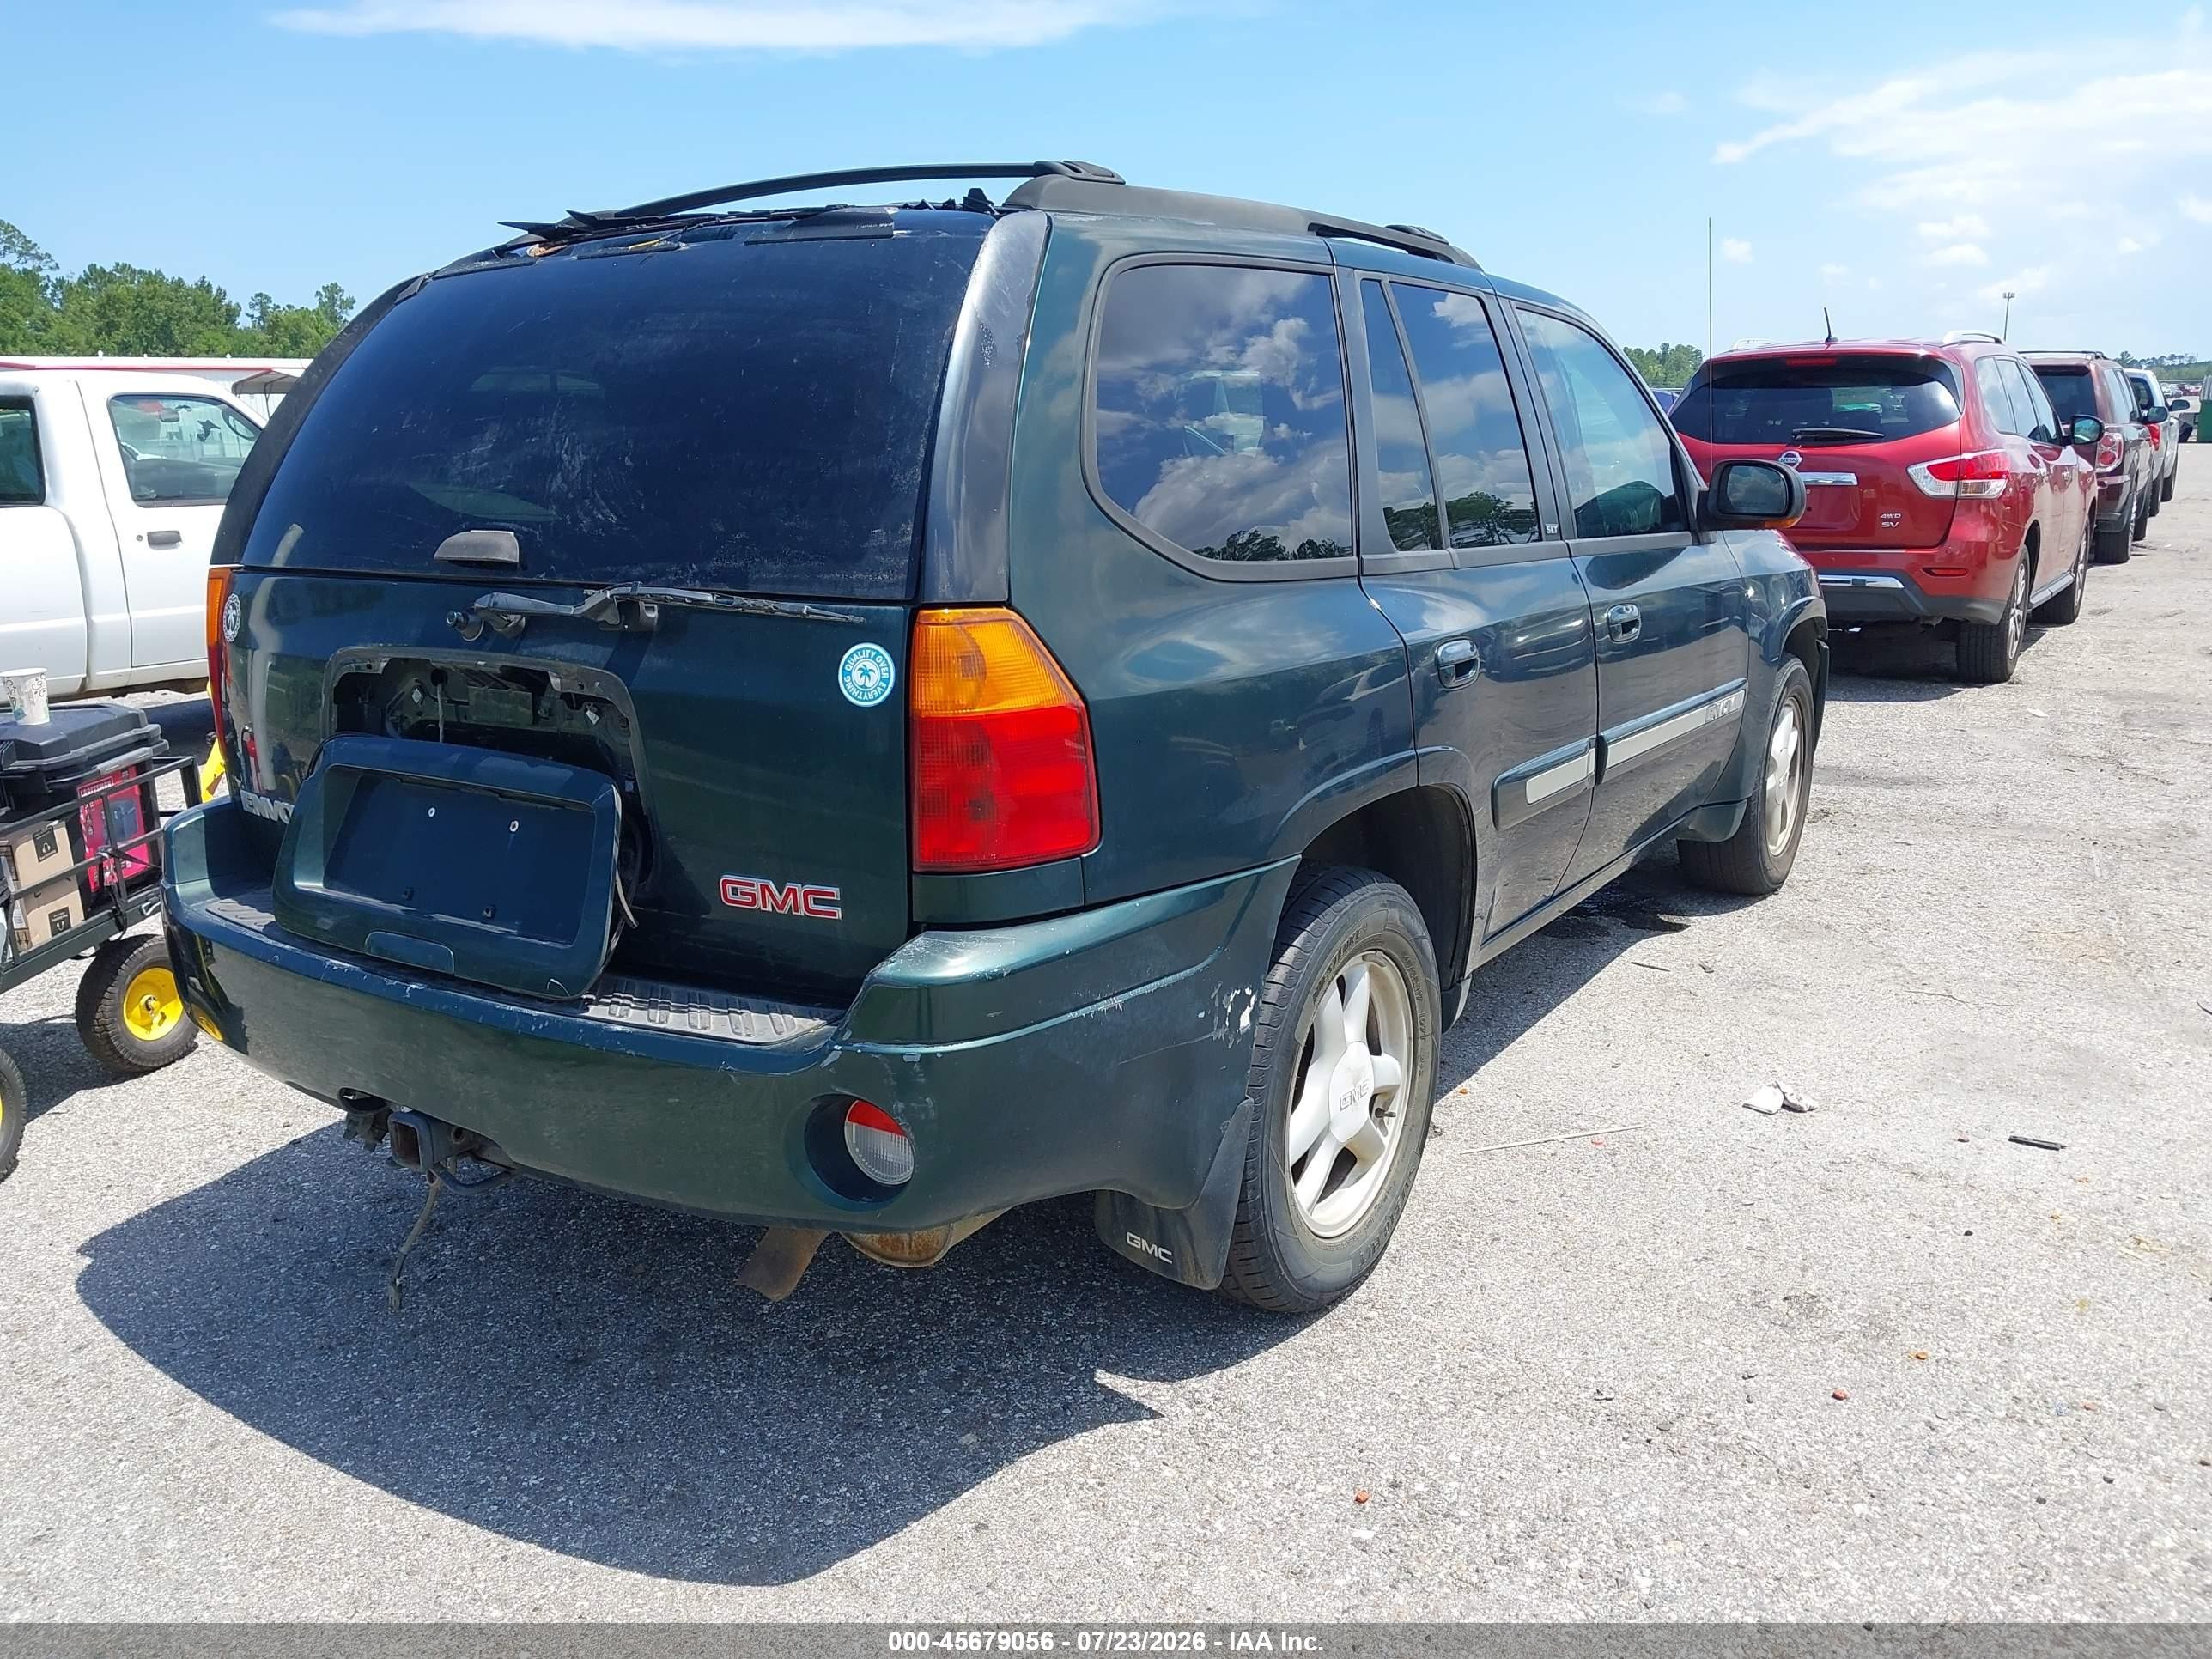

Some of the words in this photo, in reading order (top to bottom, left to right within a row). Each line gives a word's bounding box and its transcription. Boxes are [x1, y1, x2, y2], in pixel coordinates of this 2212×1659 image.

[845, 649, 876, 672] QUALITY
[875, 655, 890, 679] OVER
[843, 673, 887, 701] EVERYTHING
[720, 874, 842, 921] GMC
[1339, 1079, 1370, 1112] GMC
[1126, 1231, 1173, 1265] GMC
